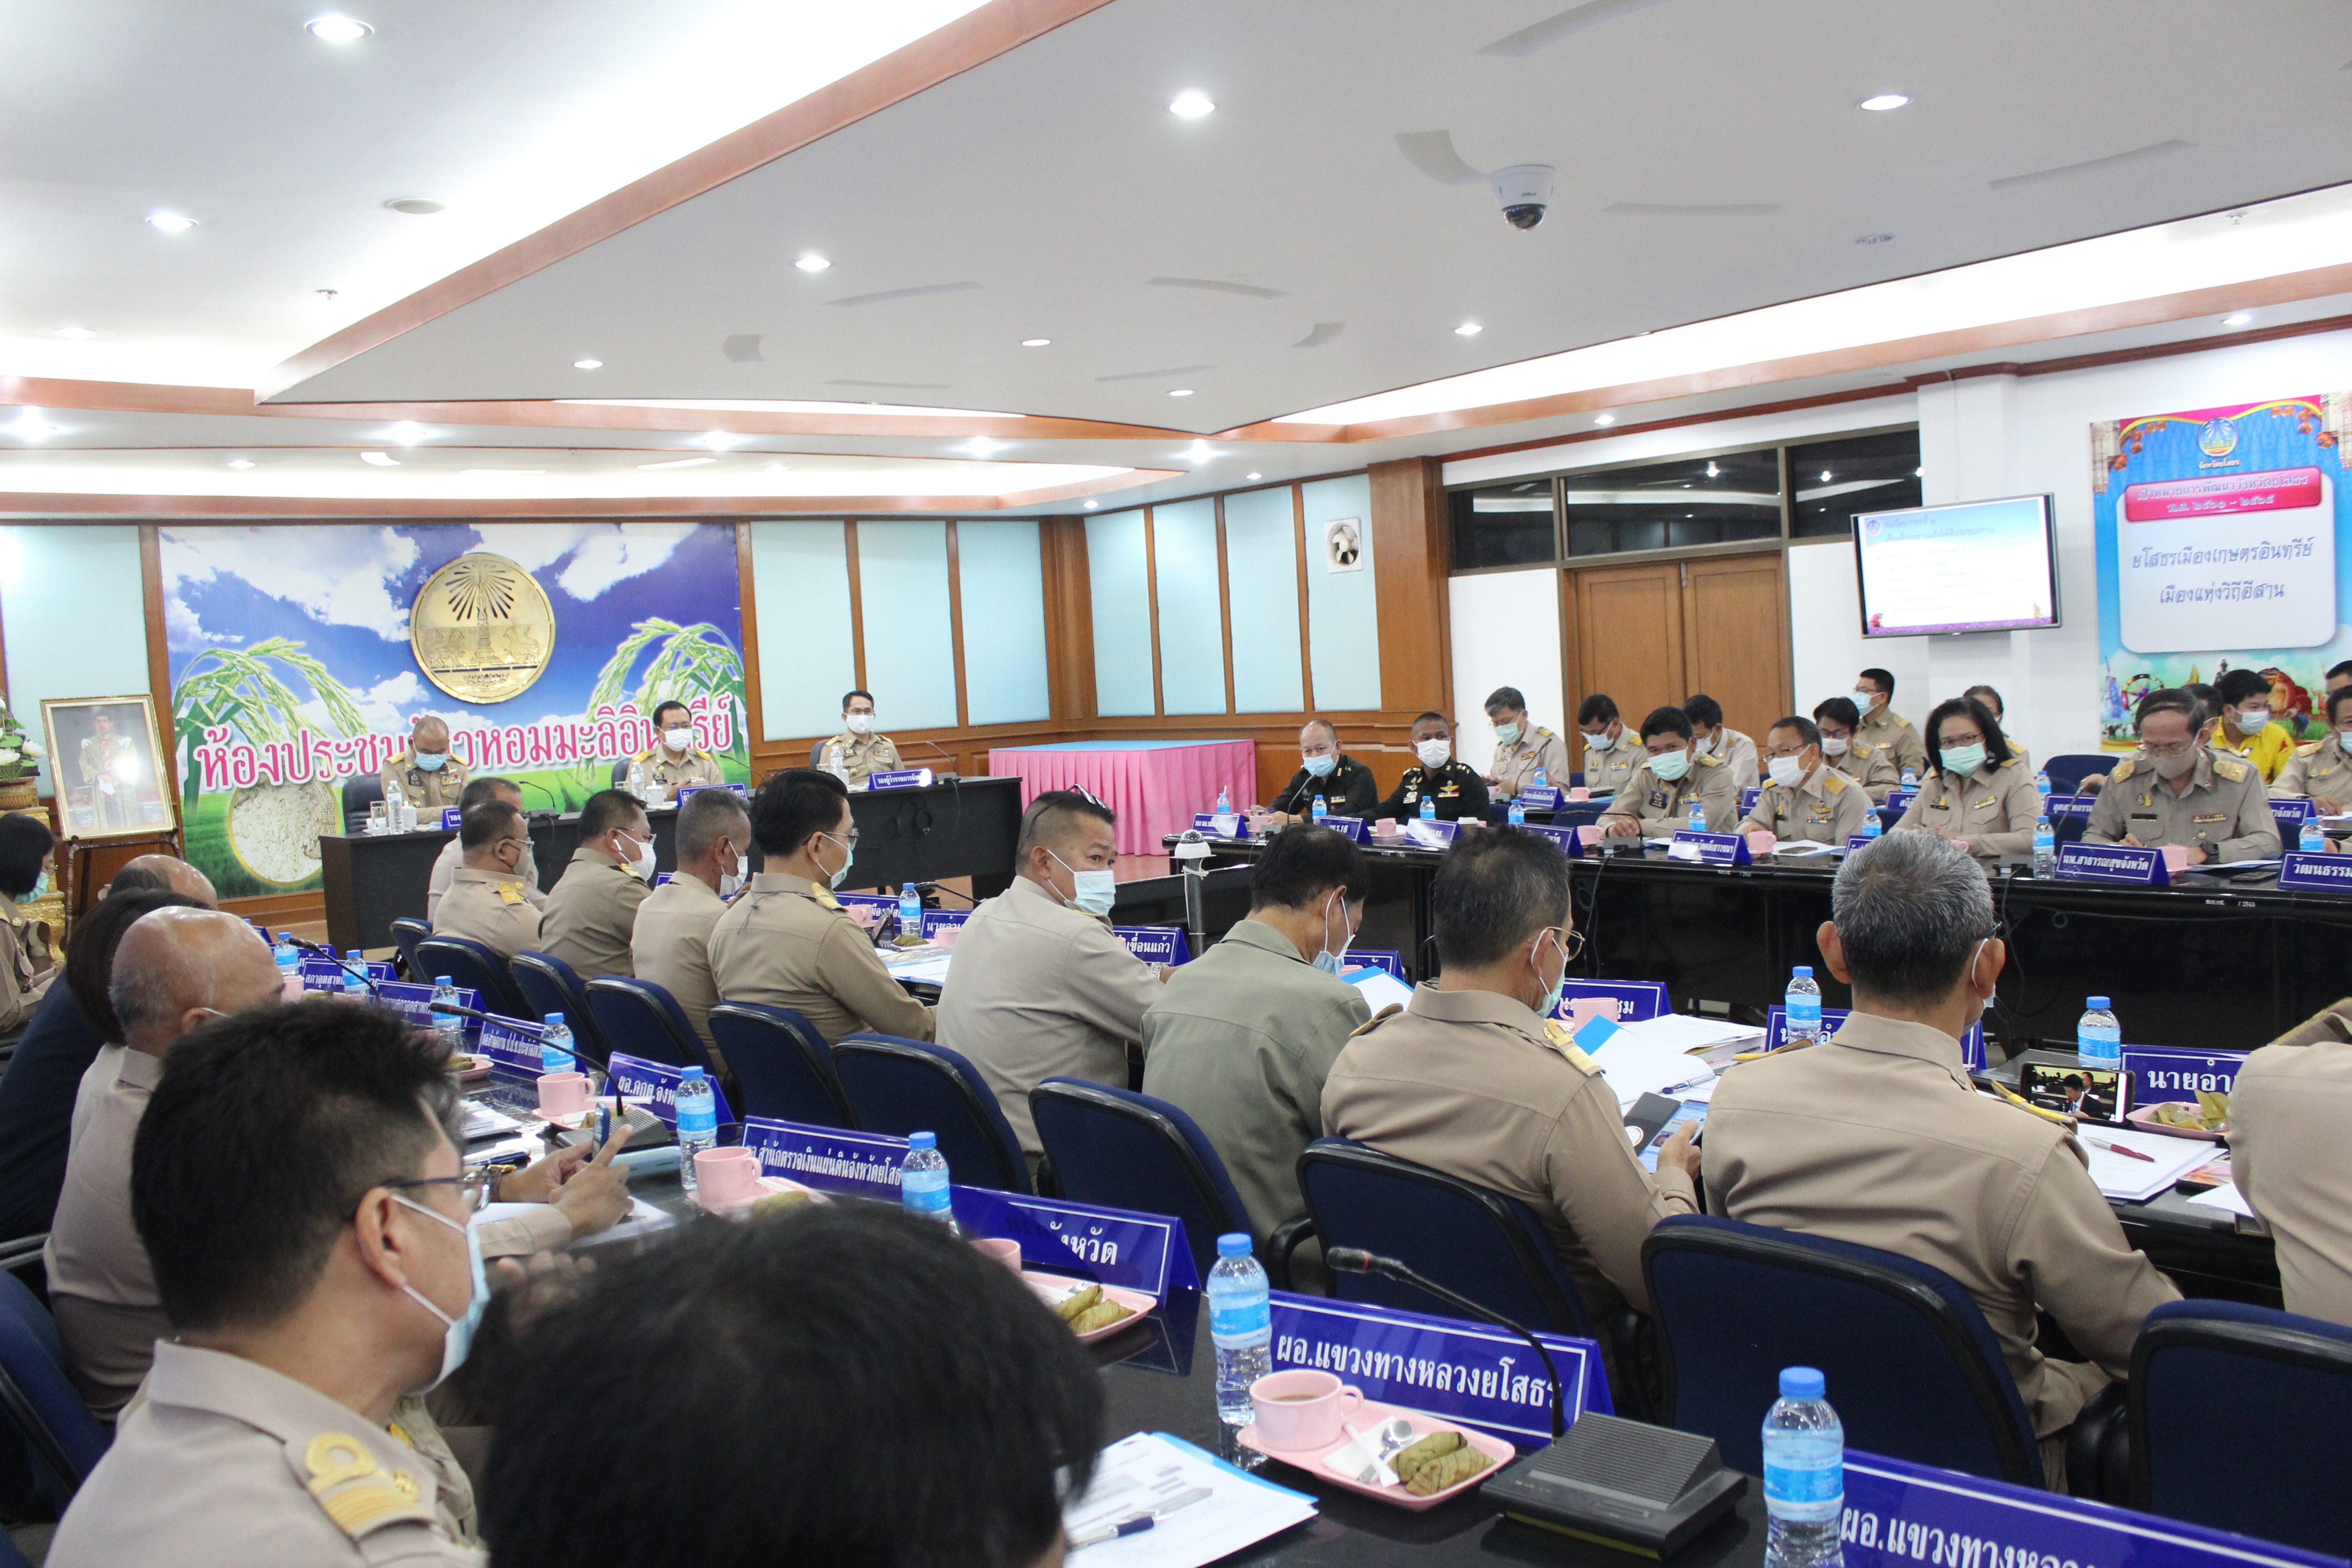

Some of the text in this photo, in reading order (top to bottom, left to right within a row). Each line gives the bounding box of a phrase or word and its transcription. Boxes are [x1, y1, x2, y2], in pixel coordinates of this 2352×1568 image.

[2136, 474, 2308, 501] เป้าหมายการพัฒนาจังหวัดยโสธร
[2132, 537, 2315, 569] ยโสธรเมืองเกษตรอินทรีย์
[2160, 581, 2284, 603] เมืองแห่งวิถีอีสาน
[2147, 1059, 2234, 1092] นายอำ
